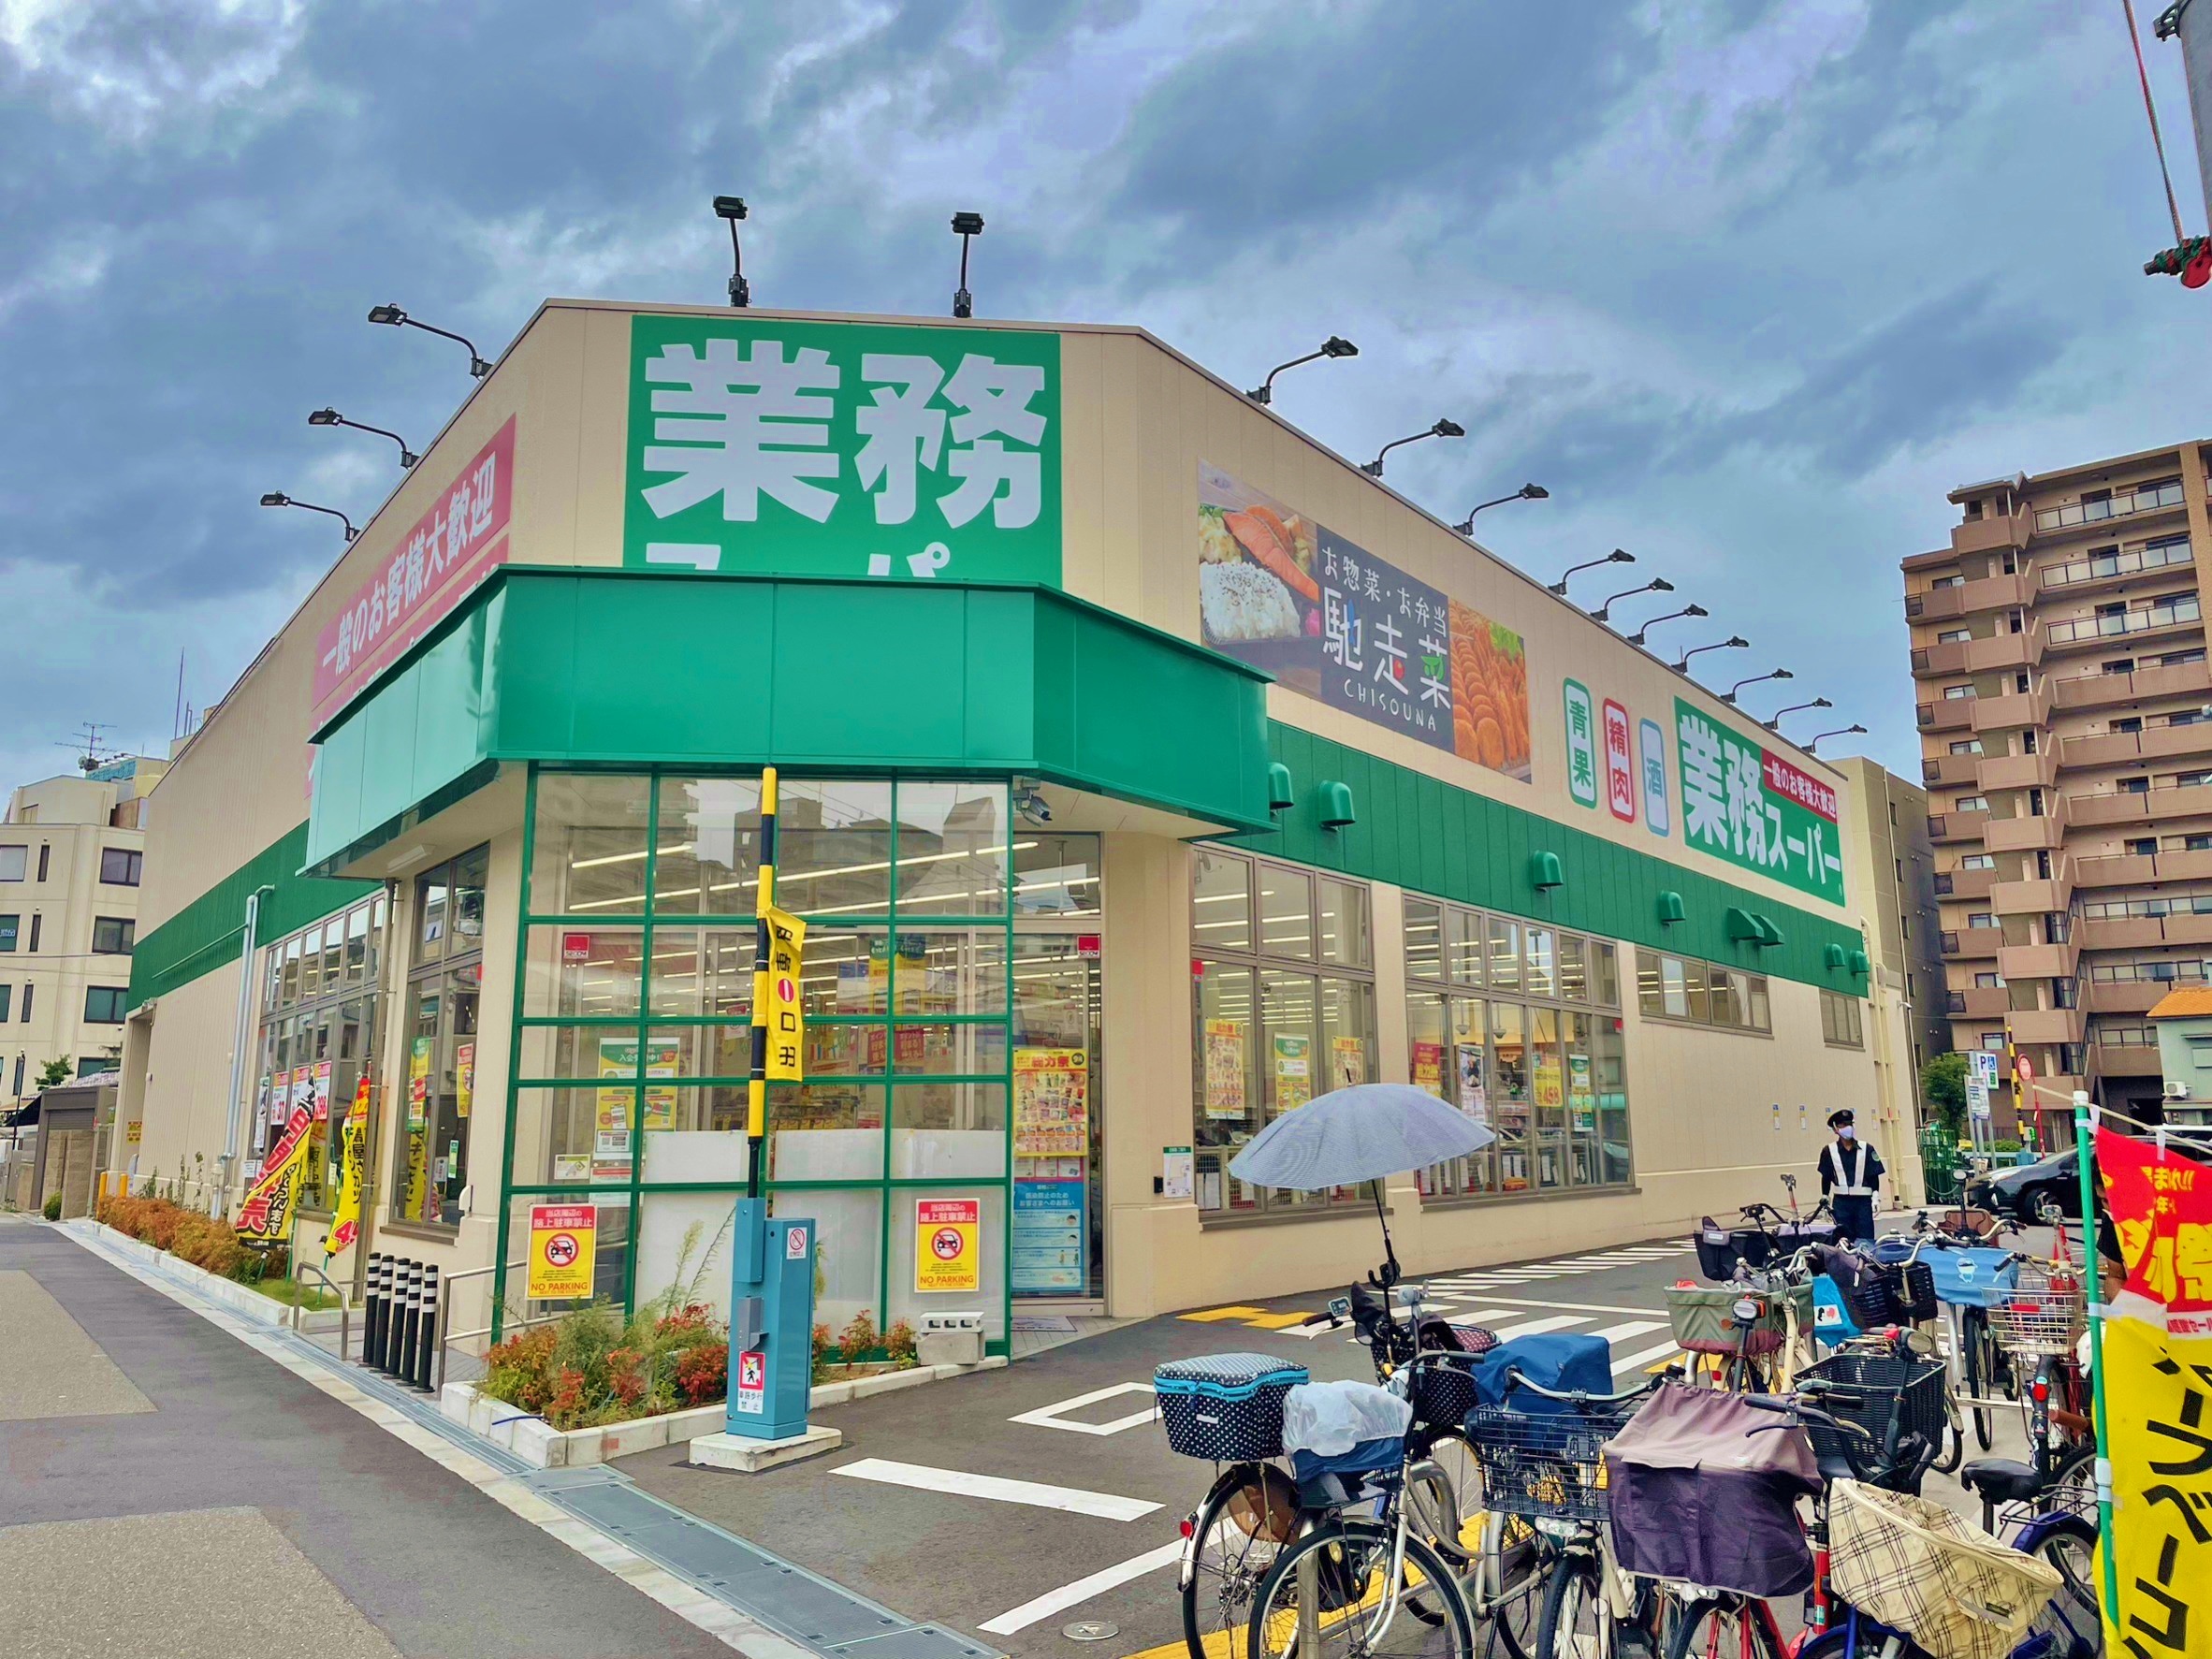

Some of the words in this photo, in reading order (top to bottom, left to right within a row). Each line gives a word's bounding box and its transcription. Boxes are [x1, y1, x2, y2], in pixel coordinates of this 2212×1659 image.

[641, 338, 1048, 529] 業務
[322, 451, 496, 676] 一般のお客様大歓迎
[1322, 546, 1447, 639] お惣菜・お弁当
[1344, 678, 1436, 732] CHISOUNA
[1569, 699, 1592, 788] 青果
[1608, 717, 1630, 805] 精肉
[1646, 757, 1664, 799] 酒
[1680, 713, 1841, 885] 業務スーパー
[1763, 760, 1837, 819] 一般のお客様大歓迎
[779, 1011, 795, 1067] 出口
[1980, 1055, 1986, 1070] P
[548, 1282, 588, 1290] PARKING
[920, 1275, 934, 1284] NO
[937, 1274, 974, 1284] PARKING
